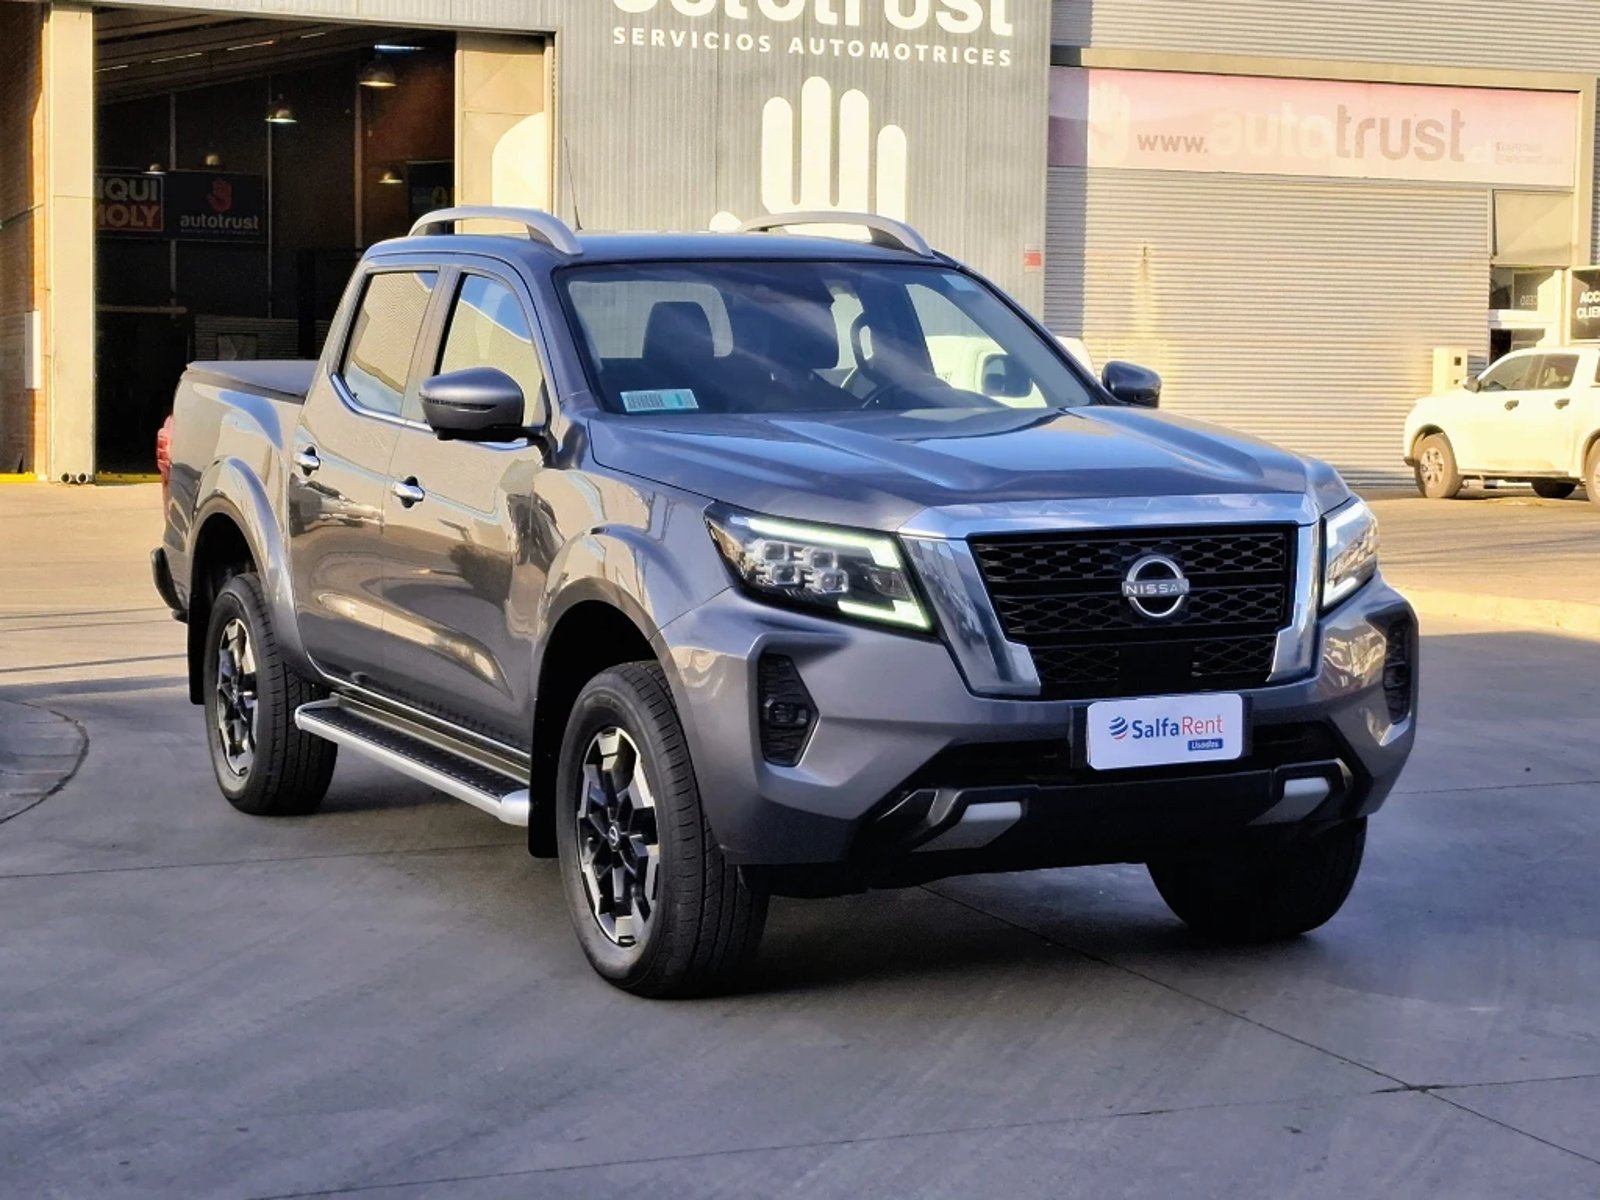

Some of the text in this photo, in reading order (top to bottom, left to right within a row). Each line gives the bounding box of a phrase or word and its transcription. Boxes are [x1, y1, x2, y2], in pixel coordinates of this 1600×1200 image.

[613, 27, 1011, 67] SERVICIOS AUTOMOTRICES
[180, 213, 258, 230] autotrust
[1125, 581, 1189, 595] NISSAN
[1132, 715, 1223, 739] SalfaRent
